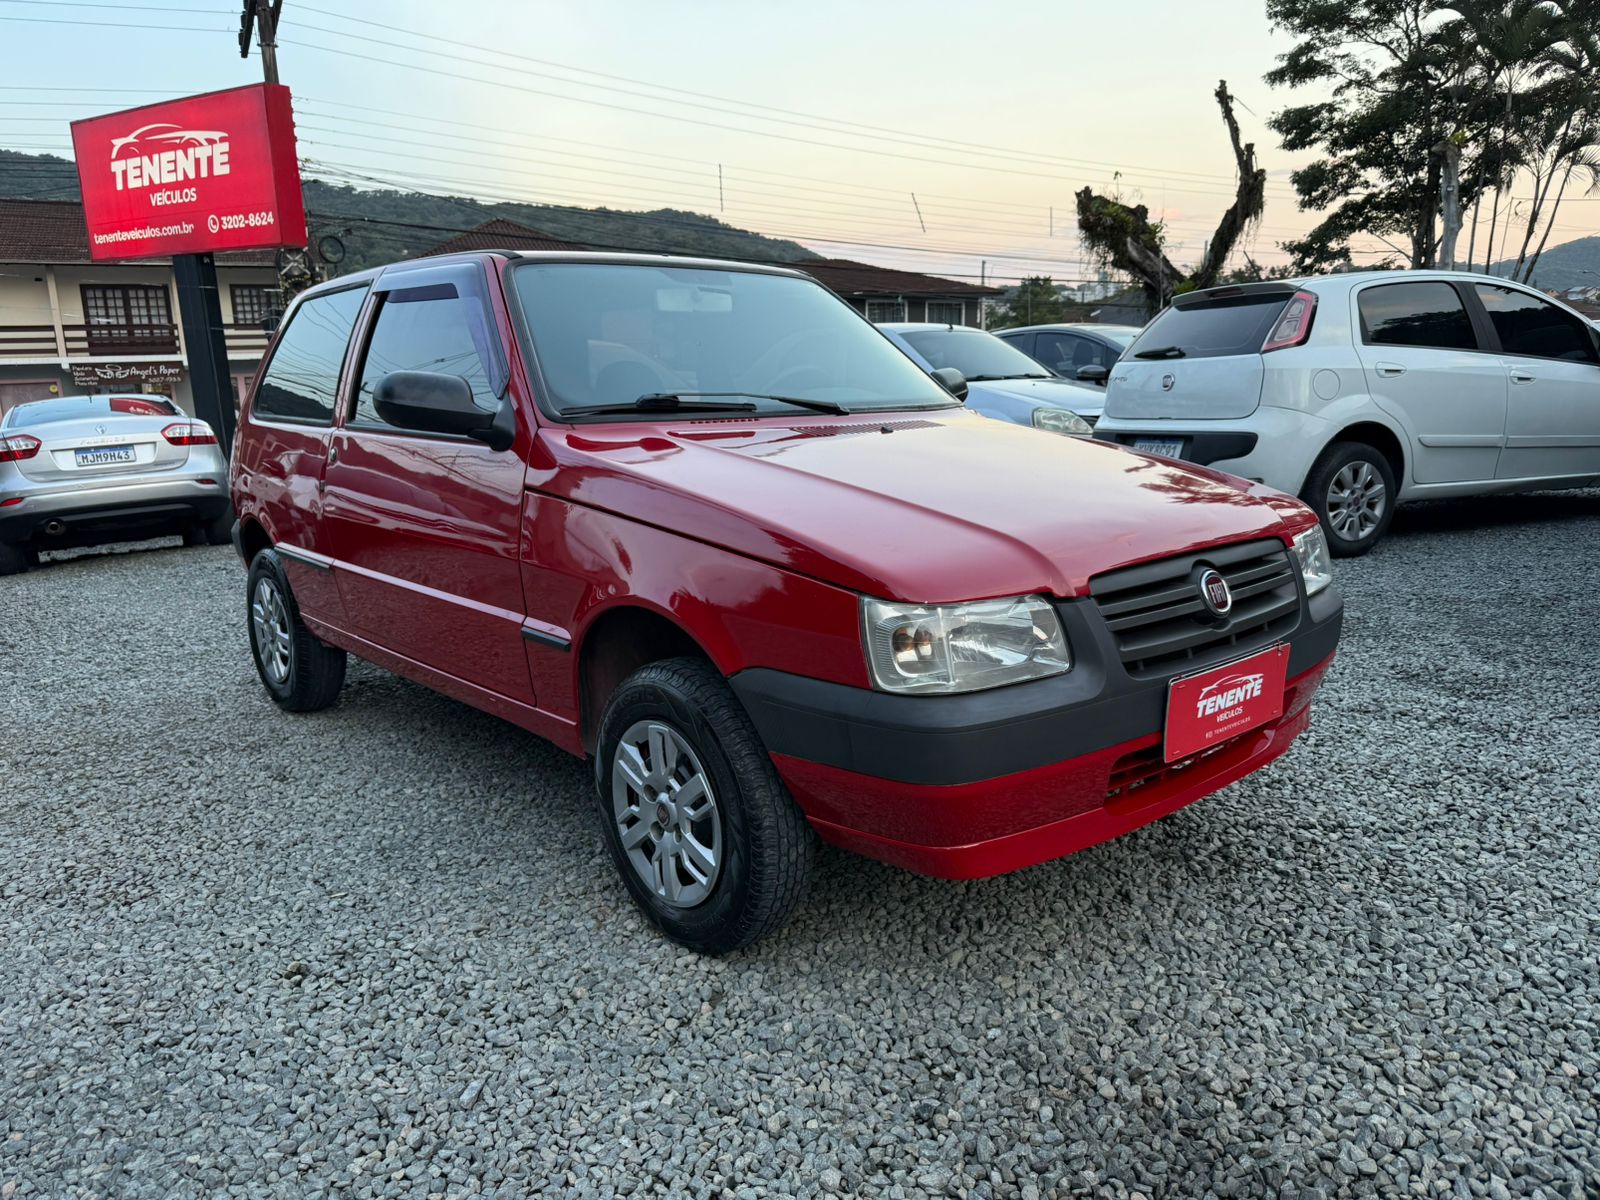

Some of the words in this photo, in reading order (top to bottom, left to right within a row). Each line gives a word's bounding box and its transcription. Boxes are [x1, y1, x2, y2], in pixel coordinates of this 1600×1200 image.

[110, 142, 230, 191] TENENTE
[150, 187, 197, 206] VEÍCULOS
[94, 222, 194, 245] tenenteveiculos.com.br
[221, 211, 274, 230] 3202-8624
[1208, 582, 1227, 603] FIAT
[1196, 678, 1264, 719] TENENTE
